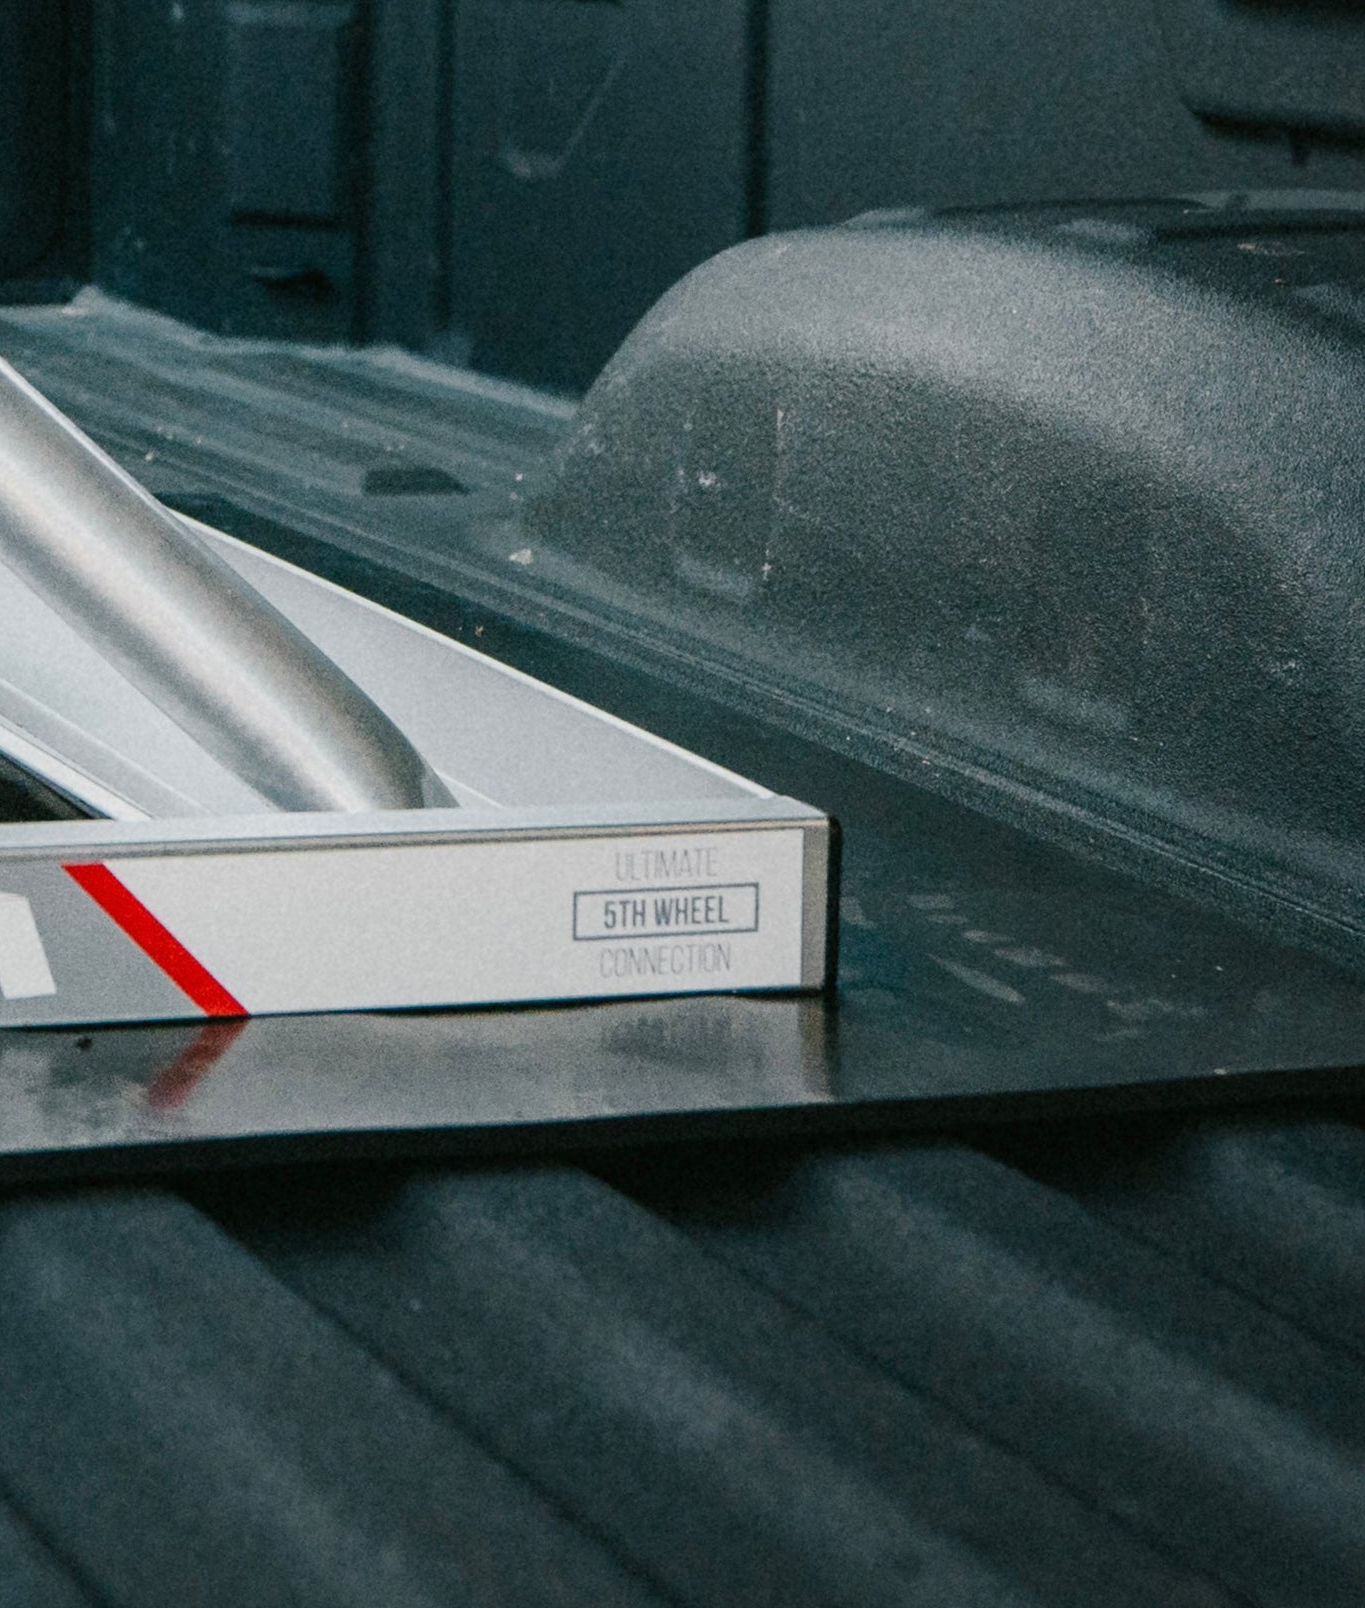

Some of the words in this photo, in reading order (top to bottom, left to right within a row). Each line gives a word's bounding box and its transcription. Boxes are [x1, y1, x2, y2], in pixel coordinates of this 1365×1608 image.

[615, 847, 718, 881] ULTIMATE
[603, 899, 646, 929] 5TH
[655, 895, 729, 927] WHEEL
[600, 942, 732, 978] CONNECTION
